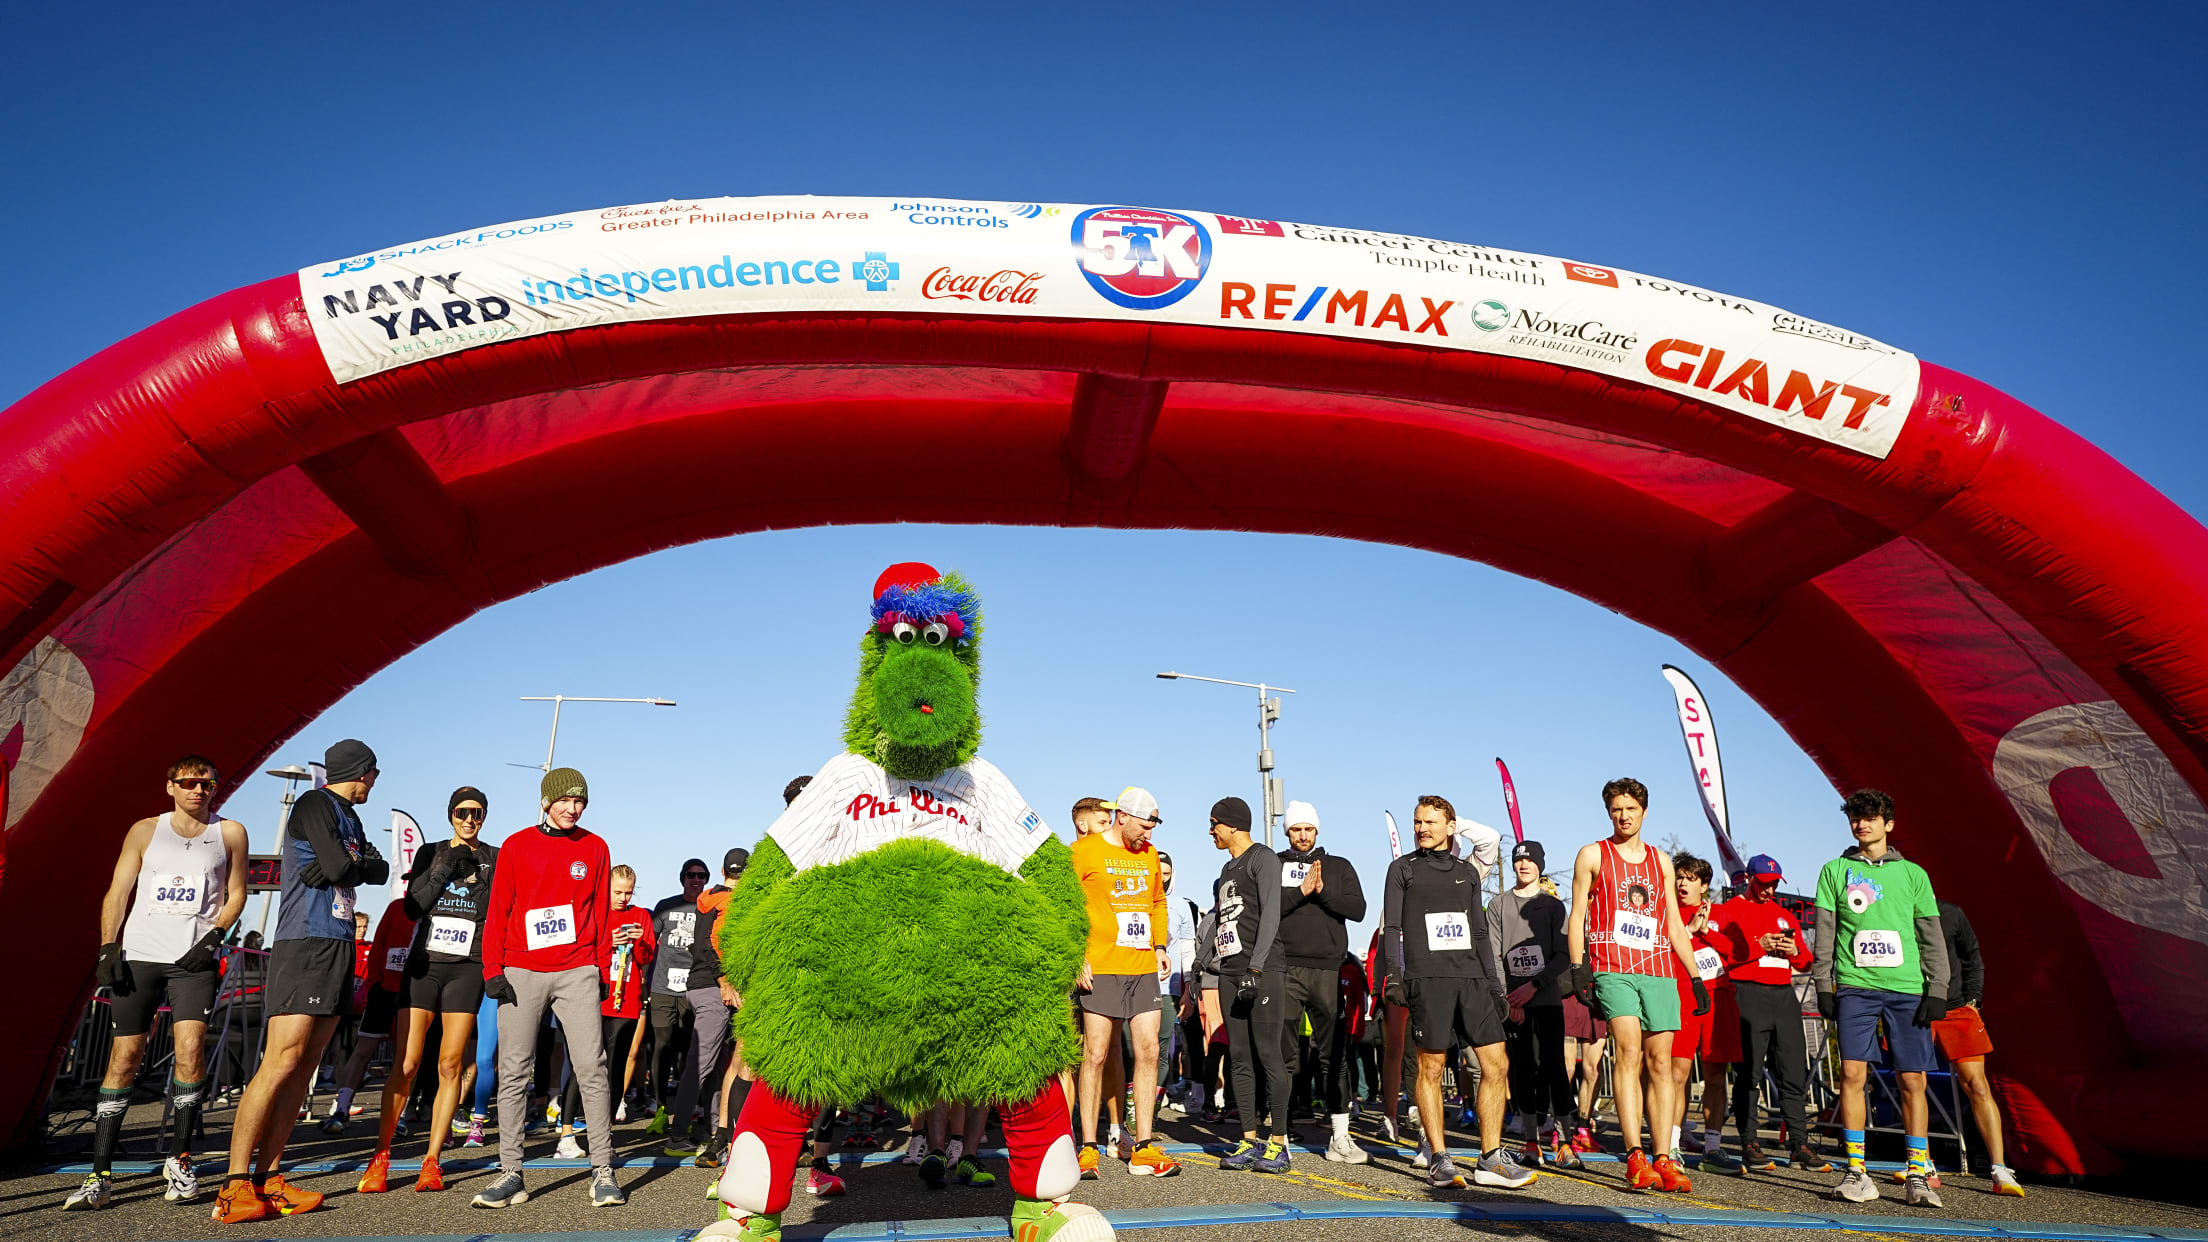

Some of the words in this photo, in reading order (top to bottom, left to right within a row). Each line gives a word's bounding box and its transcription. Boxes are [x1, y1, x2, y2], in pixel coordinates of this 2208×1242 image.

[601, 217, 682, 232] Greater
[689, 210, 816, 225] Philadelphia
[822, 210, 869, 221] Area
[890, 203, 989, 214] Johnson
[908, 213, 1009, 229] Controls
[379, 237, 472, 261] SNACK
[477, 220, 574, 242] FOODS
[1294, 228, 1416, 251] Cancer
[1427, 243, 1545, 269] Center
[521, 255, 840, 306] independence
[1370, 251, 1460, 274] Temple
[1468, 263, 1546, 287] Health
[323, 271, 462, 319] NAVY
[922, 266, 1047, 304] Coca-Cola
[1628, 276, 1755, 315] TOYOTA
[370, 295, 511, 340] YARD
[1220, 281, 1455, 336] RE/MAX
[392, 324, 520, 355] PHILADELPHIA
[1511, 308, 1638, 350] NovaCare
[1508, 334, 1627, 364] REHABILITATION
[1645, 338, 1892, 431] GIANT
[1104, 858, 1148, 868] HEROES
[1112, 868, 1144, 876] HERO
[1290, 869, 1308, 880] 69
[156, 887, 196, 902] 3423
[533, 918, 567, 936] 1526
[1435, 924, 1464, 938] 2412
[1620, 922, 1651, 940] 4034
[1512, 954, 1539, 968] 2155
[1859, 942, 1896, 955] 2336
